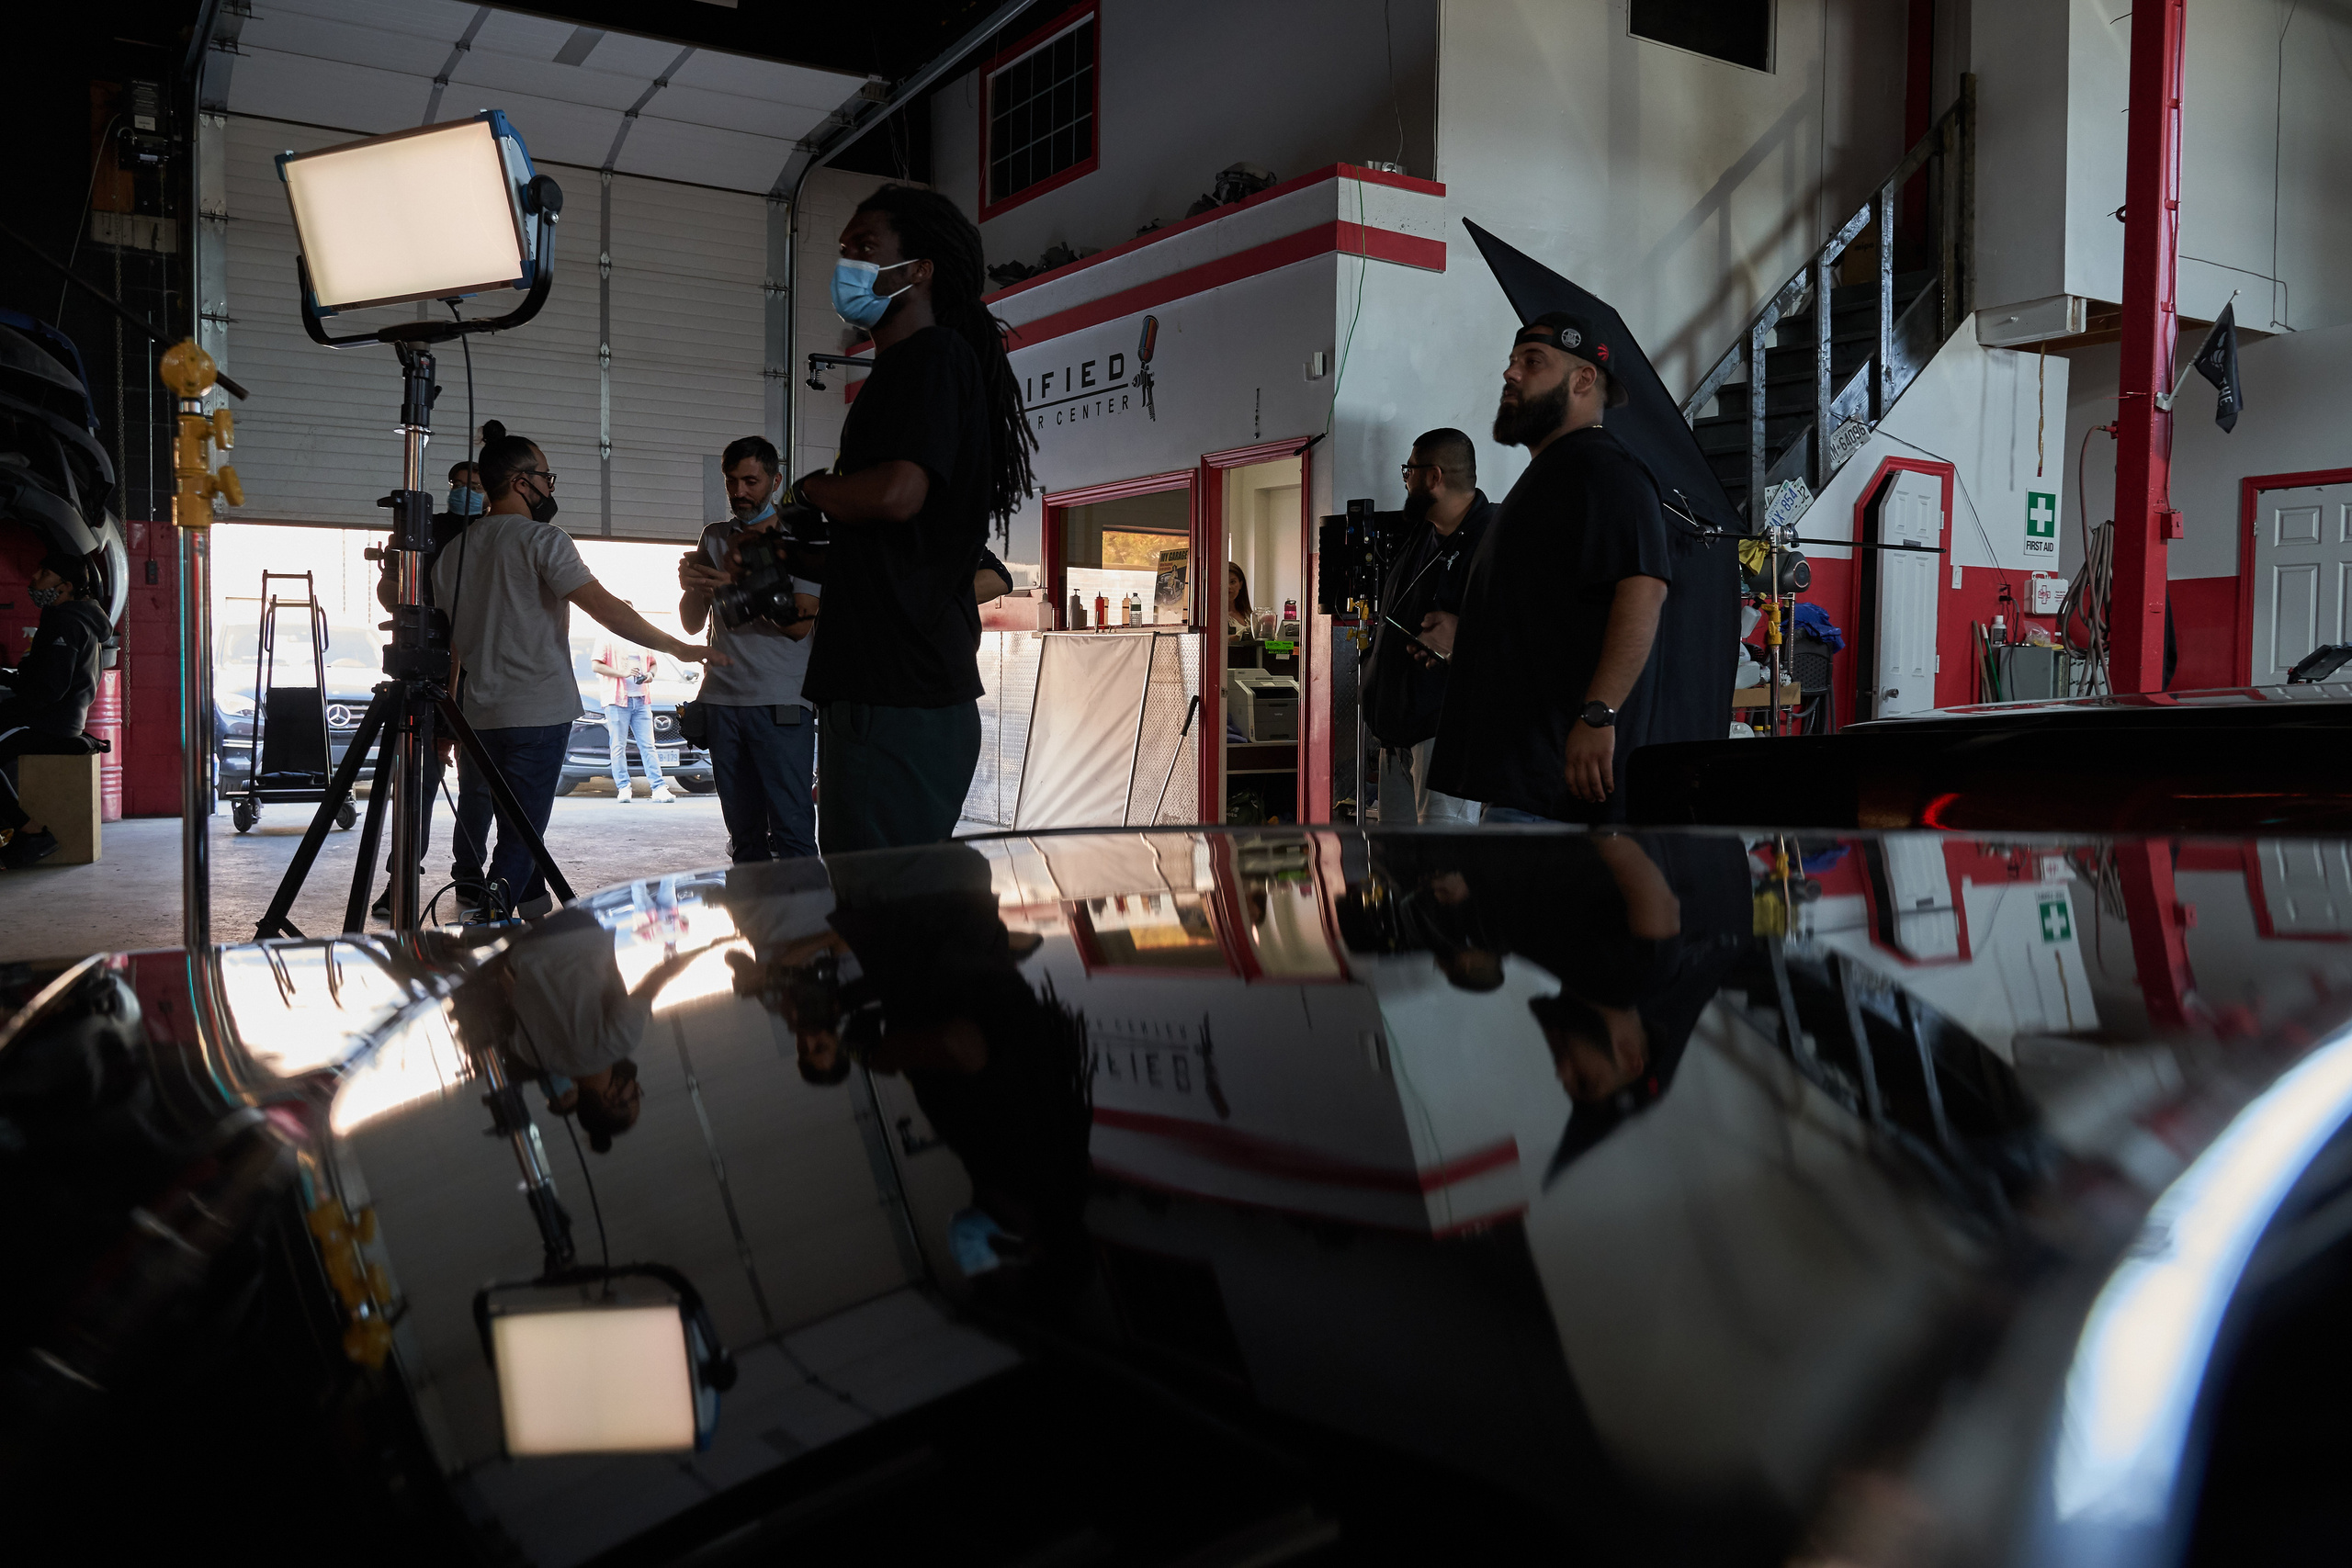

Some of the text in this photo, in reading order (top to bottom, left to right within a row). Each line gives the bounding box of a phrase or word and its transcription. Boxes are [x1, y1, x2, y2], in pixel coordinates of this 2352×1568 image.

[1027, 353, 1125, 402] IFIED
[2218, 377, 2233, 407] THE
[1056, 394, 1129, 426] CENTER
[1781, 487, 1798, 512] 854
[1159, 550, 1188, 562] MY GARAGE
[2026, 540, 2054, 552] FIRST AID
